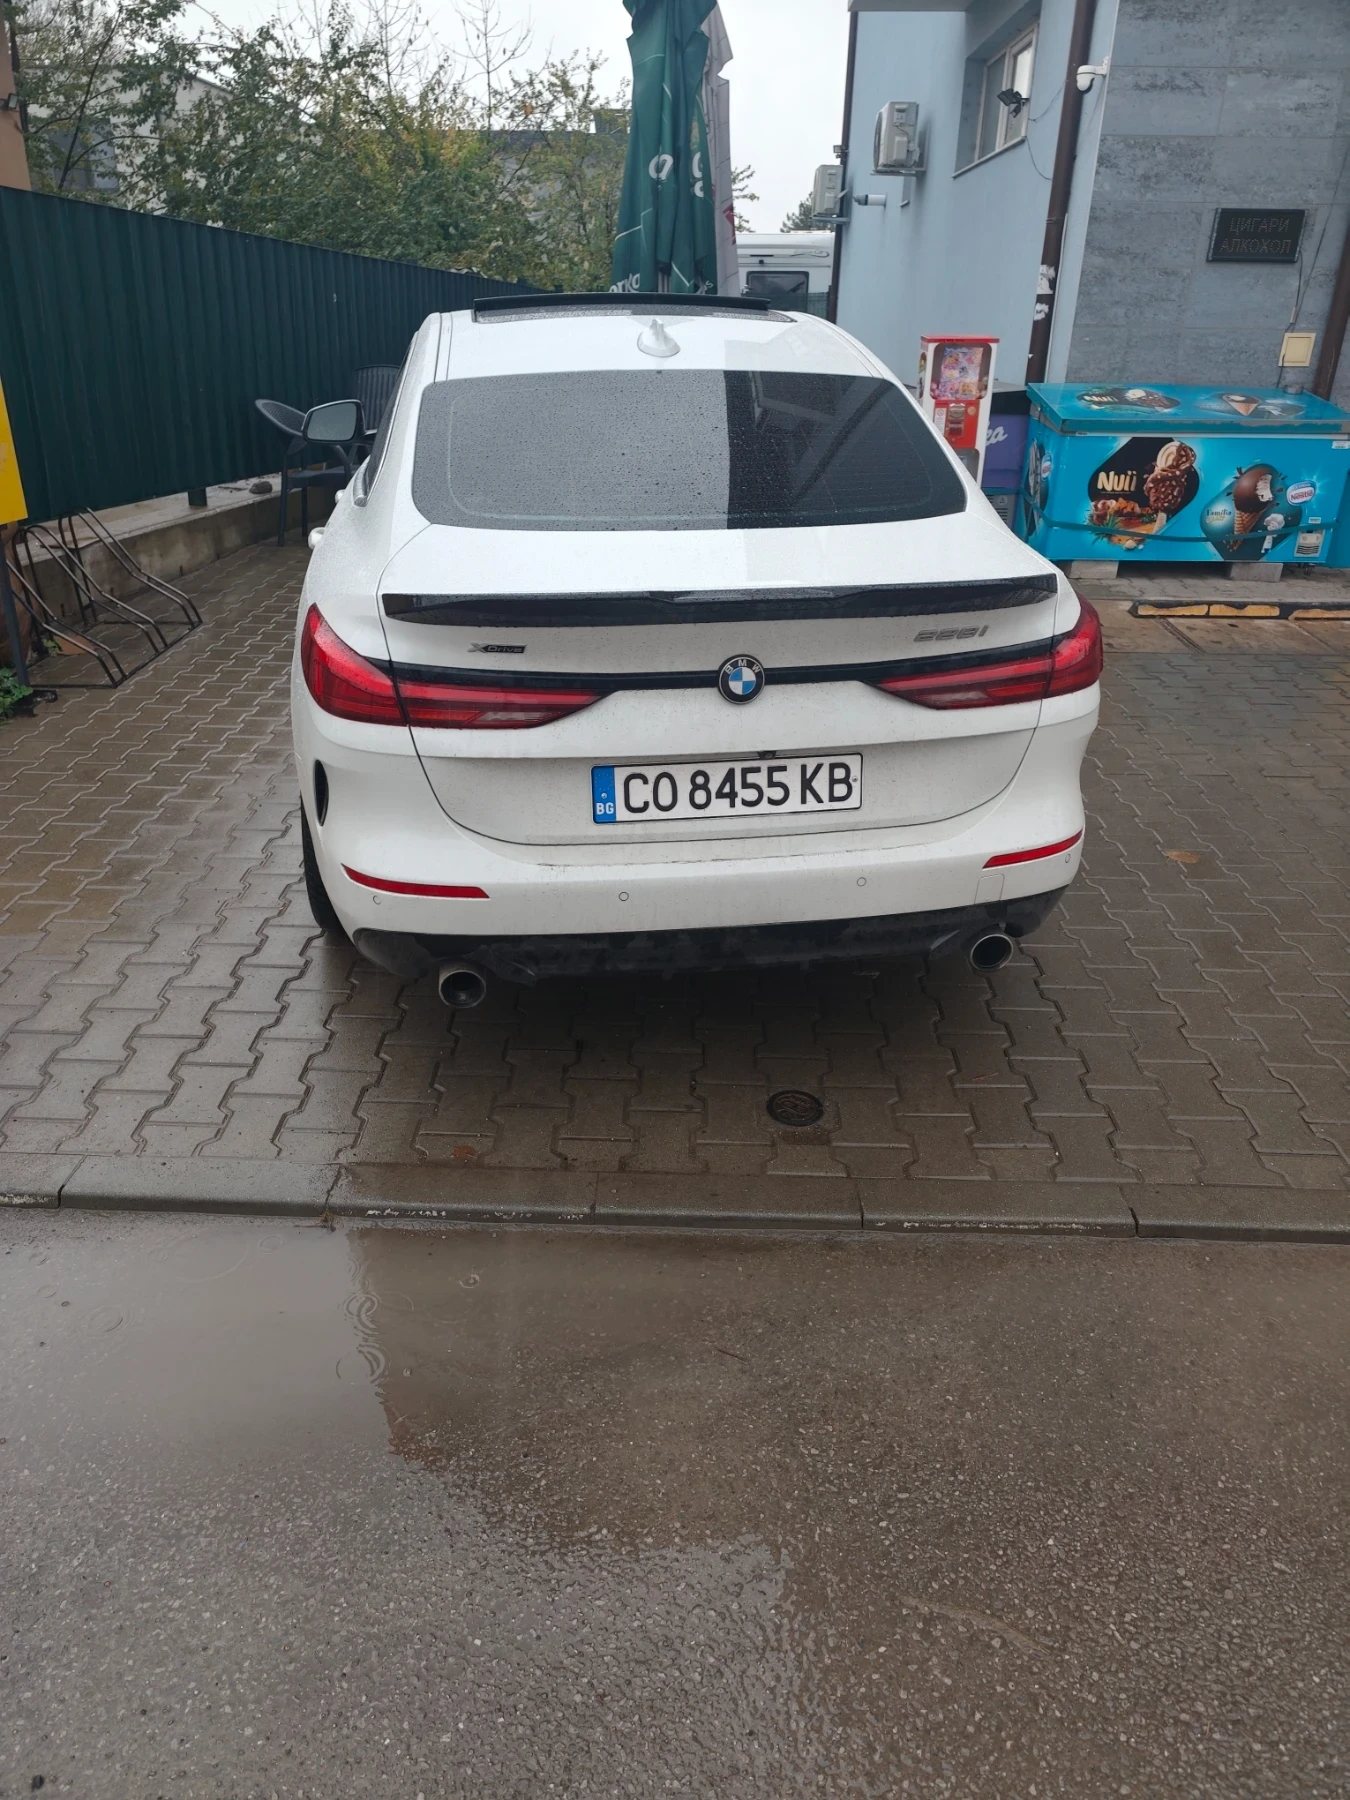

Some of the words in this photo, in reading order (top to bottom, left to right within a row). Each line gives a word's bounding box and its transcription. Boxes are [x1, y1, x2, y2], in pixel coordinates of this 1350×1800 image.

[1229, 217, 1290, 236] ЦИГАРИ
[1219, 238, 1292, 253] АЛКОХОЛ
[724, 659, 761, 675] BMW
[688, 765, 790, 810] 8455
[800, 762, 853, 804] KB
[596, 802, 614, 815] BG
